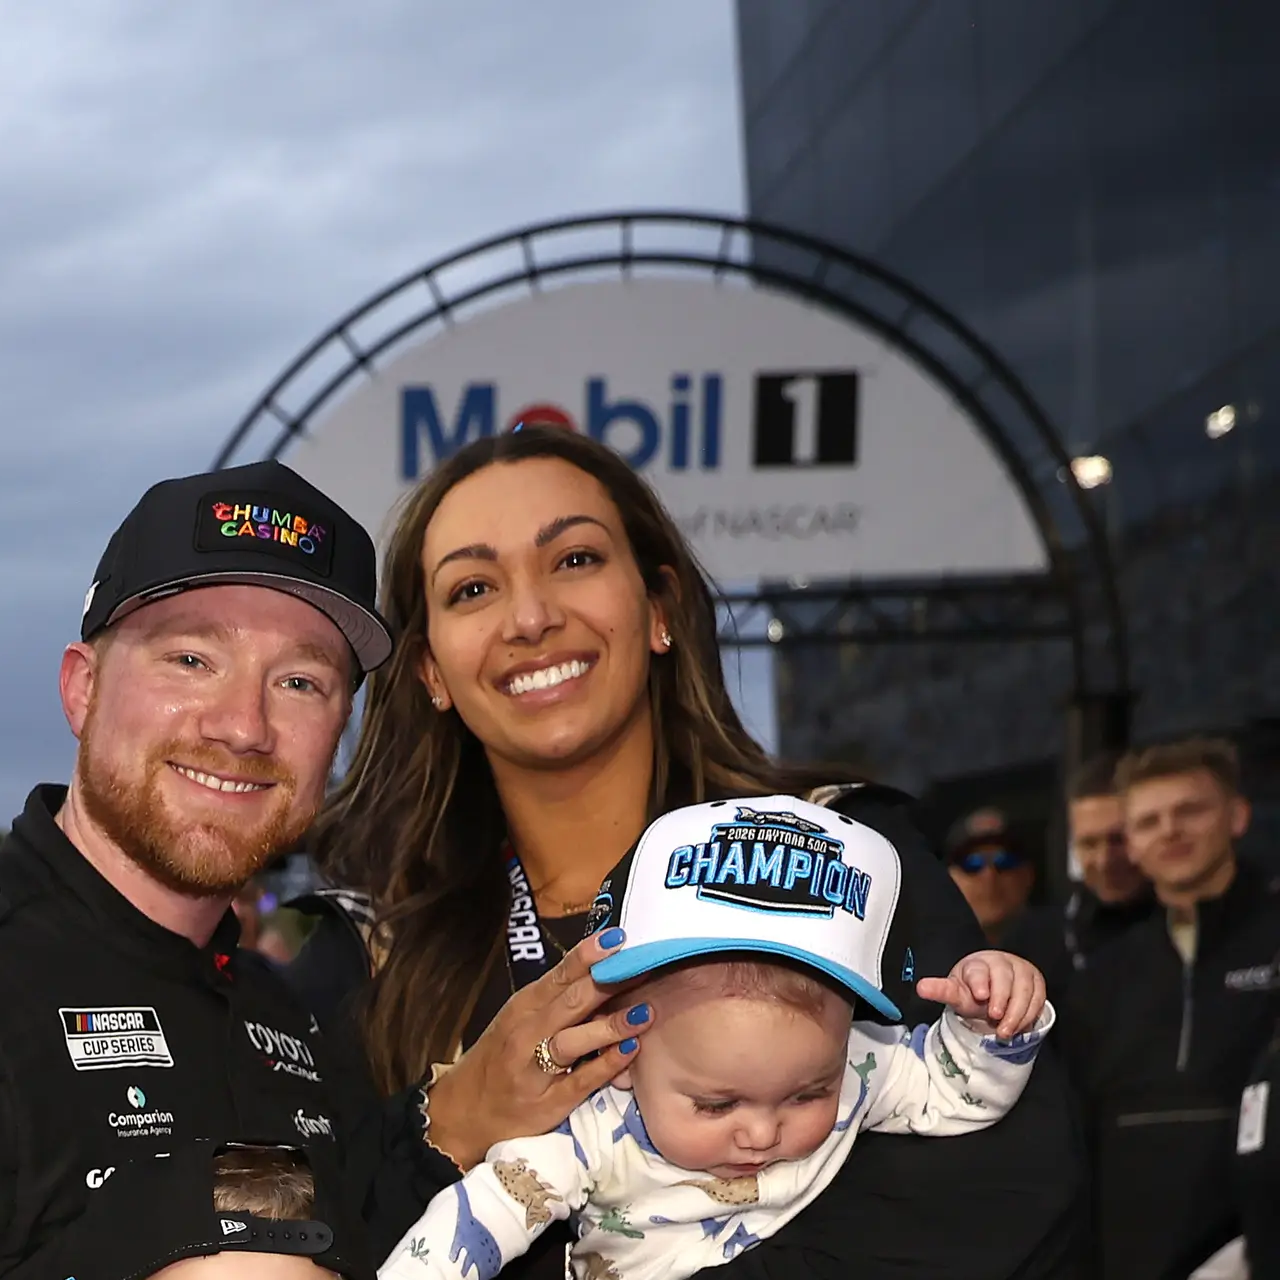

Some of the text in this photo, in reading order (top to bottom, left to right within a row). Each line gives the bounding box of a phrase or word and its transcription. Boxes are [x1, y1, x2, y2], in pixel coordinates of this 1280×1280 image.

[212, 501, 326, 542] CHUMBA
[220, 521, 316, 554] CASINO
[727, 827, 829, 853] 2026 DAYTONA 500
[666, 840, 873, 921] CHAMPION
[91, 1012, 146, 1032] NASCAR
[82, 1036, 155, 1056] CUP SERIES
[108, 1109, 174, 1128] Comparion
[117, 1125, 172, 1138] Insurance Agency
